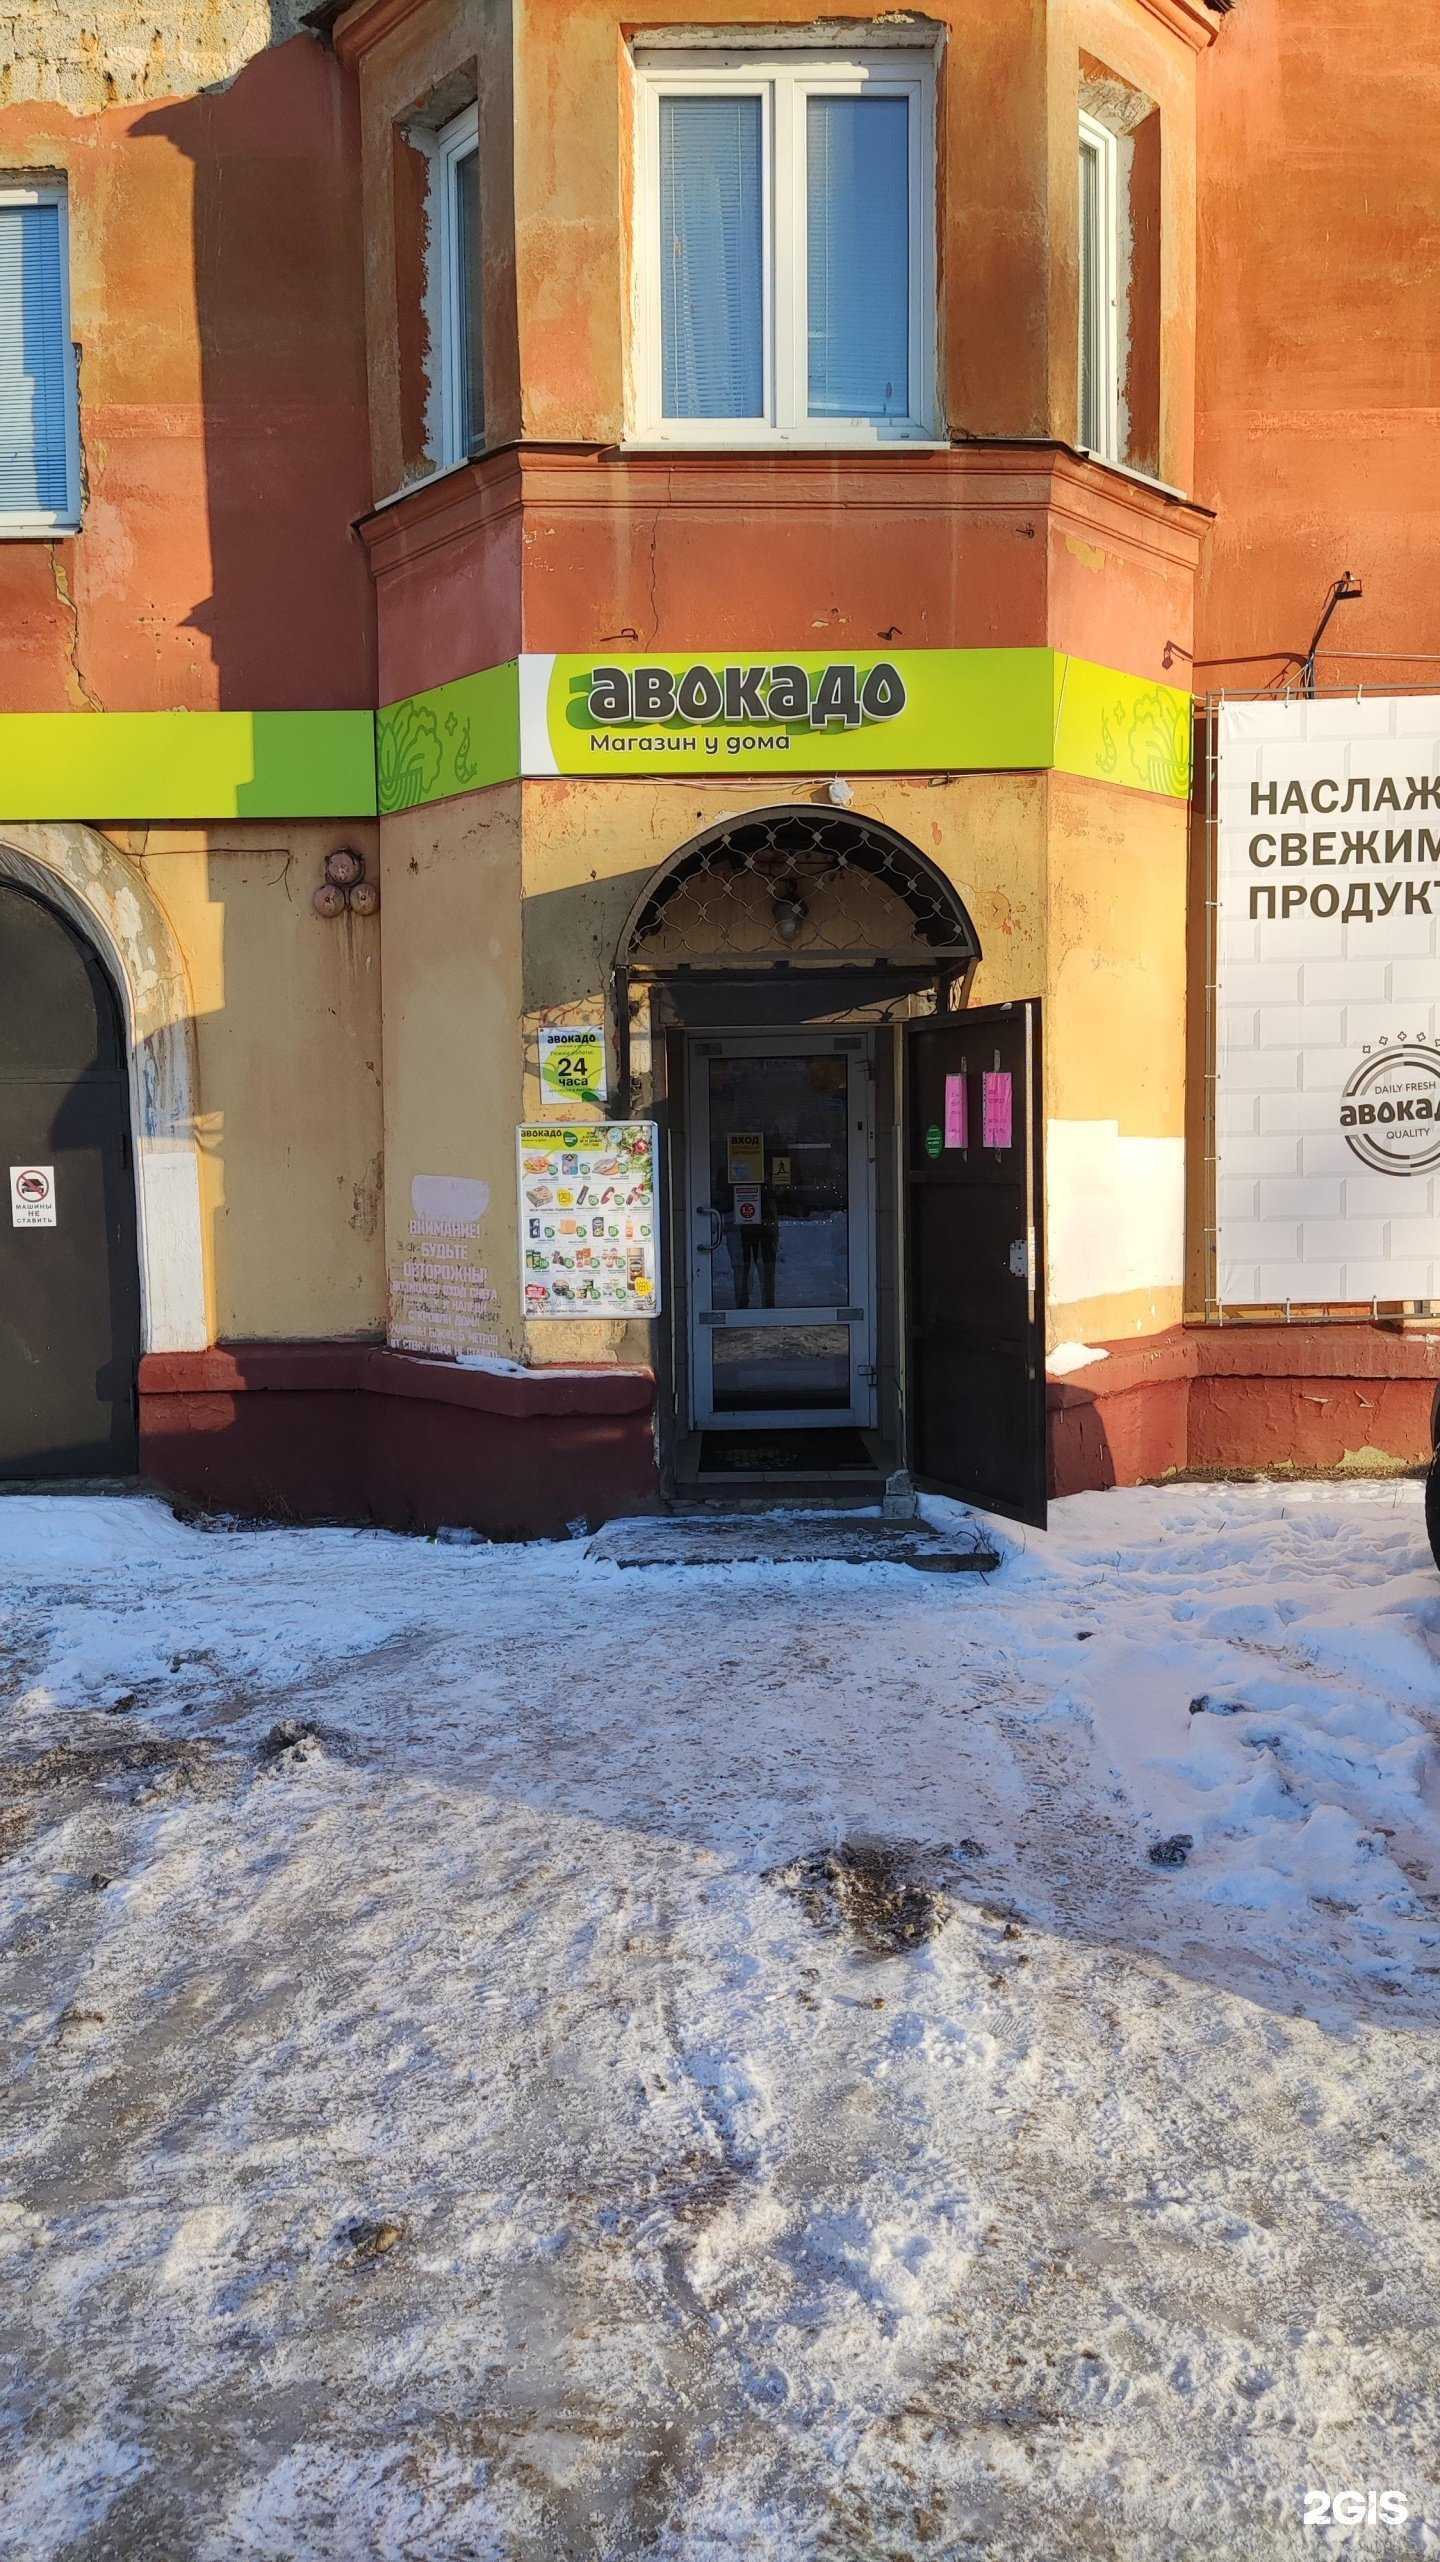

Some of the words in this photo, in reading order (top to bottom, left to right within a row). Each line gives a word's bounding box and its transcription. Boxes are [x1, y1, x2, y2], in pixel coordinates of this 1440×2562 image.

[588, 663, 906, 729] авокадо
[590, 734, 696, 751] Магазин
[705, 737, 718, 755] у
[726, 733, 790, 753] дома
[1250, 776, 1440, 815] НАСЛАЖ
[1250, 880, 1440, 923] ПРОДУК
[547, 1034, 596, 1044] авокадо
[558, 1057, 587, 1076] 24
[559, 1078, 588, 1086] часа
[1375, 1084, 1402, 1095] DAILY
[1406, 1081, 1436, 1092] FRESH
[521, 1129, 562, 1138] авокадо
[731, 1136, 759, 1145] ВХОД
[1386, 1128, 1430, 1140] QUALITY
